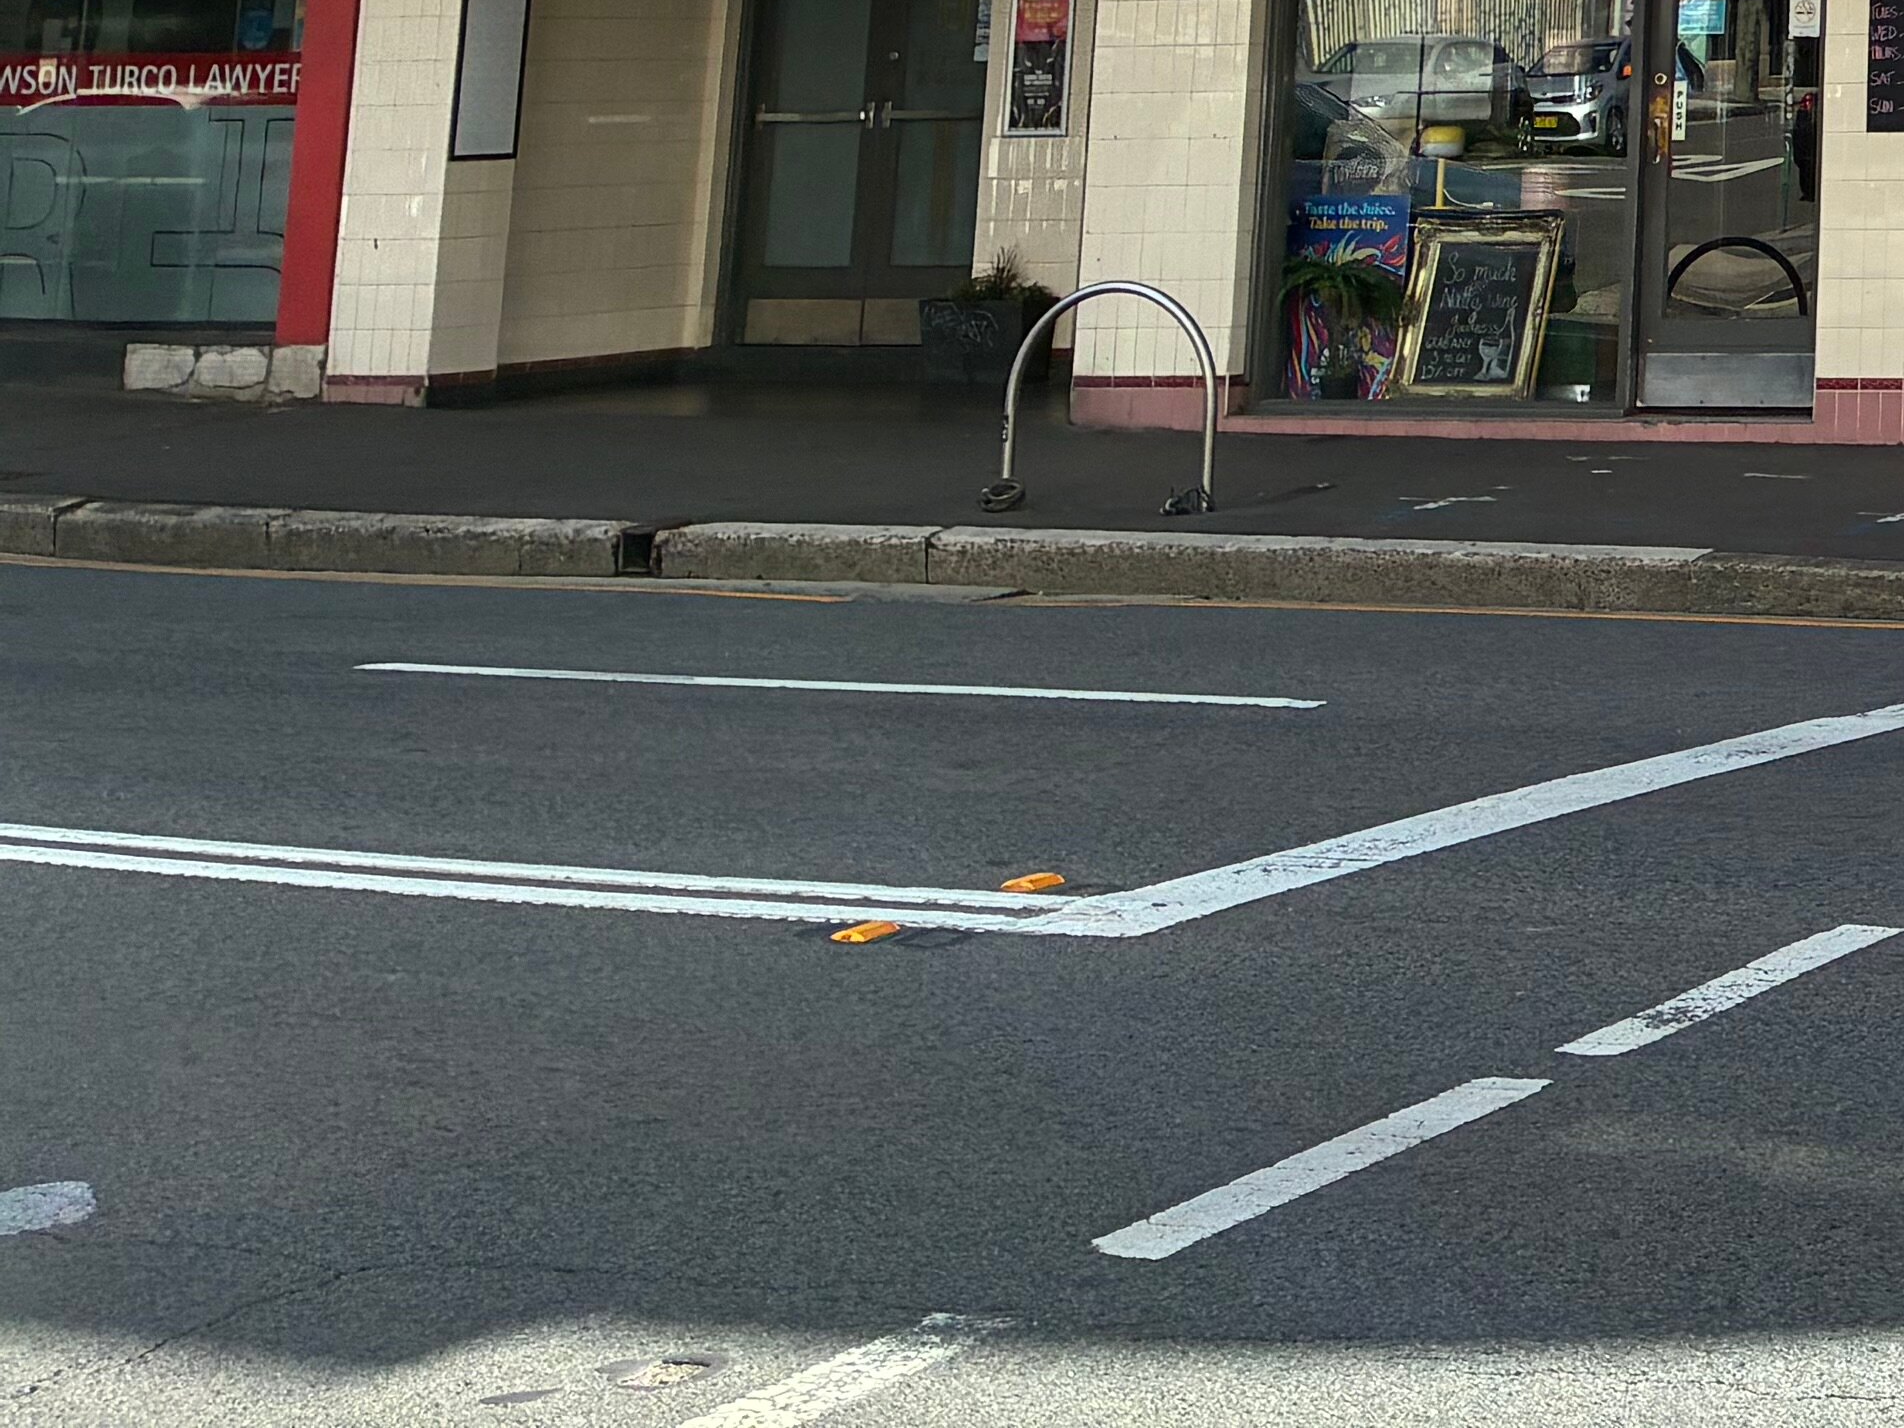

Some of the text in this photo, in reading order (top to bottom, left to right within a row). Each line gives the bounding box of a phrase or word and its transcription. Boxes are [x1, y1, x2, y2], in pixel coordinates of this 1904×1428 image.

[89, 64, 177, 94] TURCO
[1338, 201, 1358, 216] the
[1309, 217, 1389, 233] Take the trip.
[1443, 251, 1517, 284] So much
